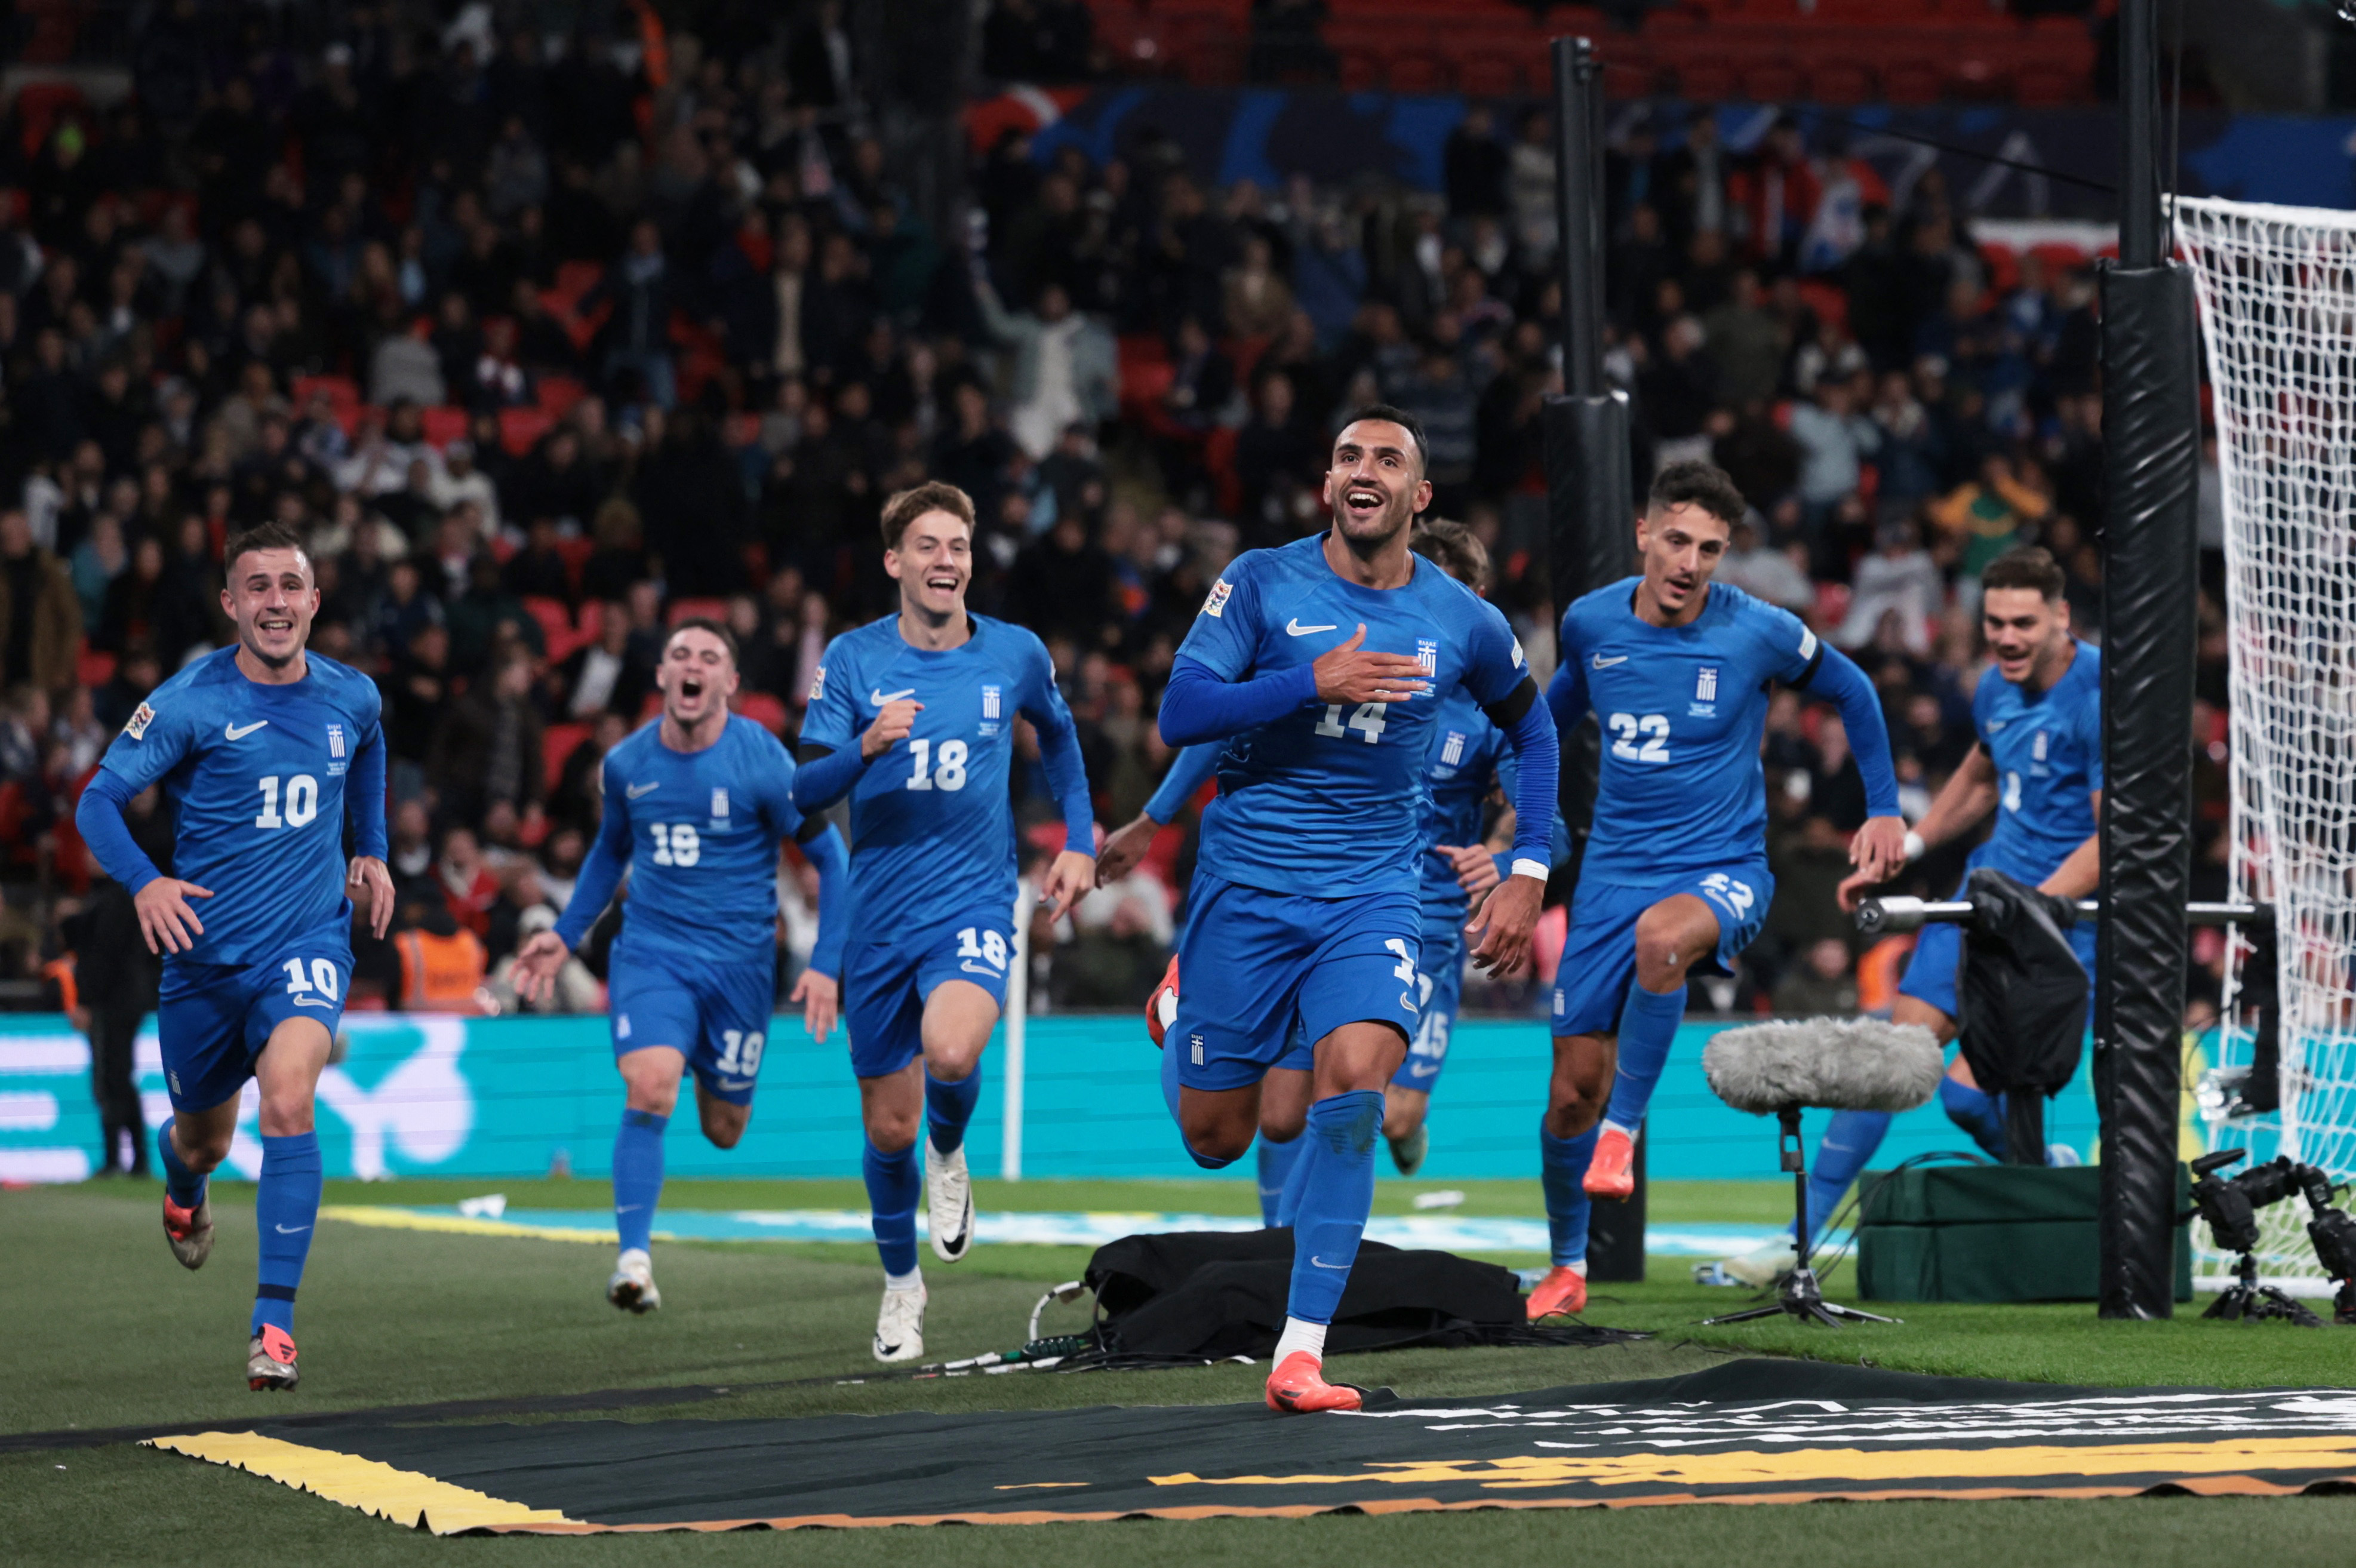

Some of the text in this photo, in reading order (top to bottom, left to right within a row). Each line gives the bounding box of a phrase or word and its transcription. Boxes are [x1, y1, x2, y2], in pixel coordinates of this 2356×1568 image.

[1314, 702, 1388, 745] 14
[1608, 712, 1671, 763] 22
[906, 739, 968, 791] 18
[256, 774, 318, 829] 10
[650, 823, 700, 867] 19
[957, 927, 1007, 971] 18
[1385, 938, 1416, 989] 1
[282, 957, 338, 1002] 10
[717, 1030, 764, 1076] 19
[1410, 1011, 1448, 1060] 15
